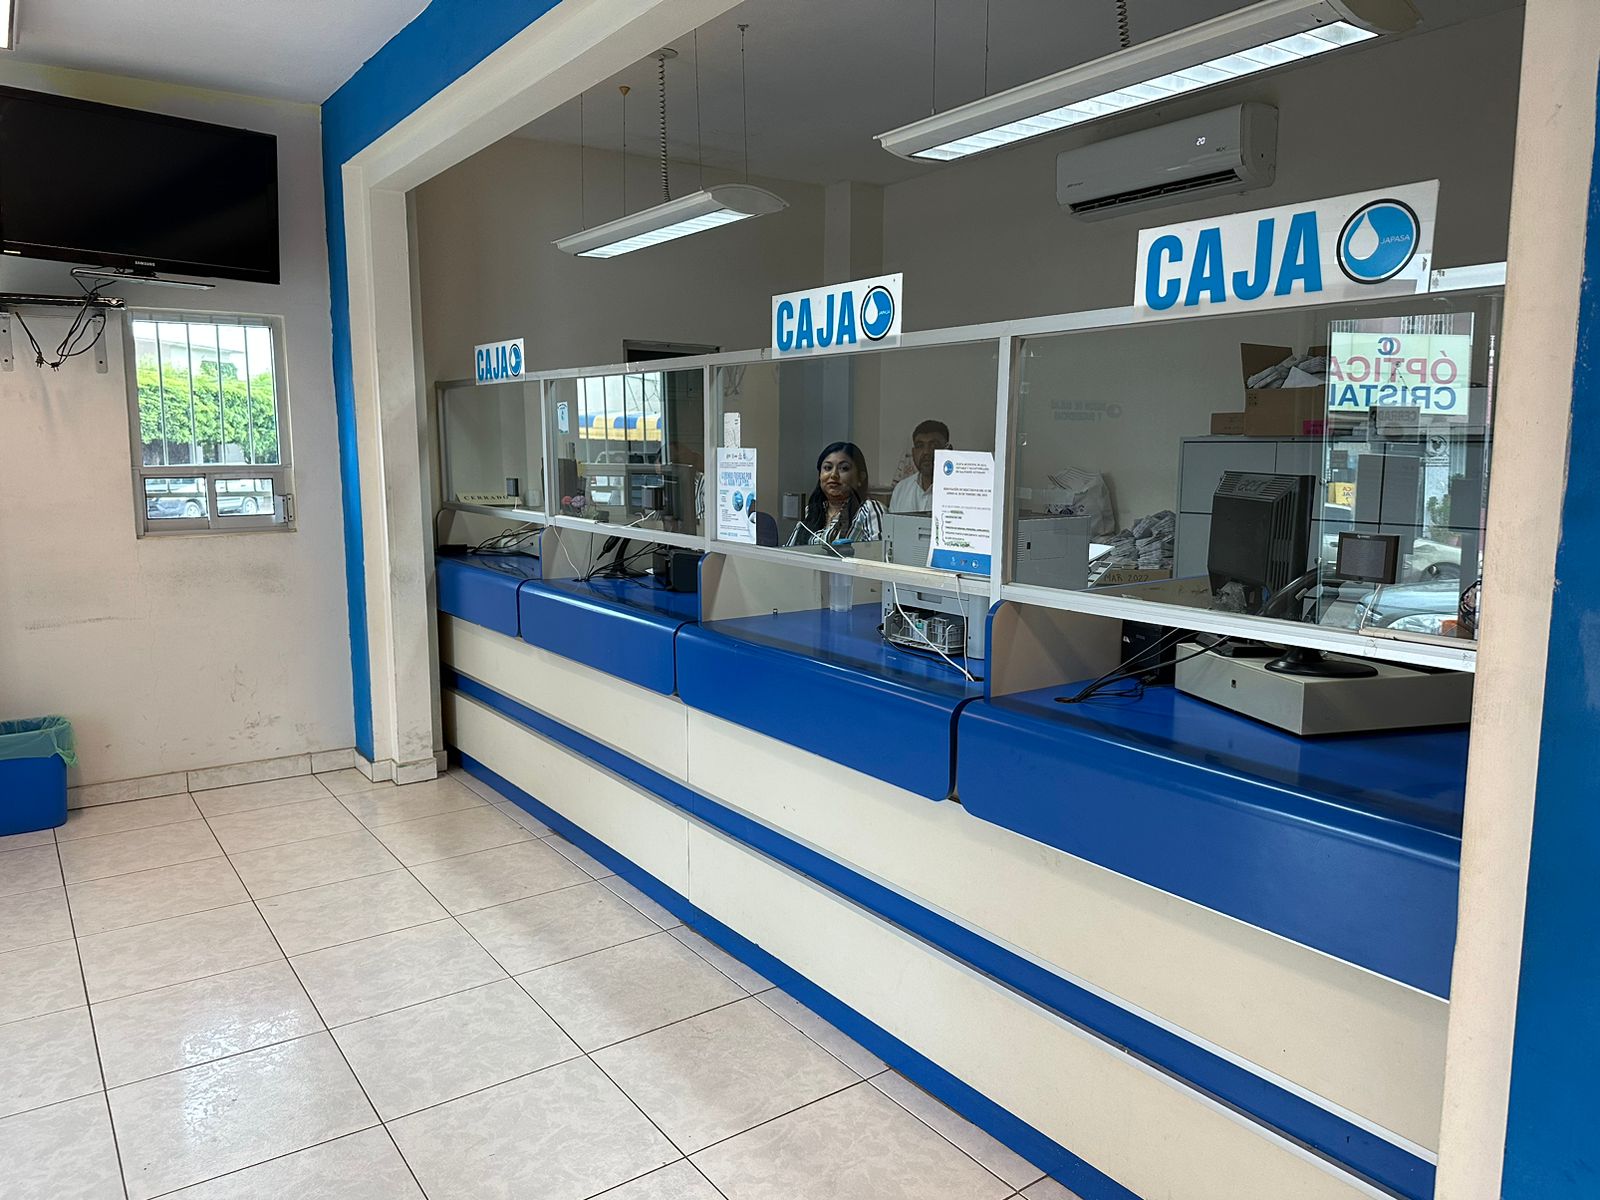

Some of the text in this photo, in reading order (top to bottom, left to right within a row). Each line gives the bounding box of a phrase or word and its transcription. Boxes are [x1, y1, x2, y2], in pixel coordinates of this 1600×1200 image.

[1380, 233, 1411, 245] JAPASA
[1145, 210, 1323, 311] CAJA
[776, 290, 857, 352] CAJA
[476, 345, 509, 381] CAJA
[1104, 573, 1123, 583] MAR
